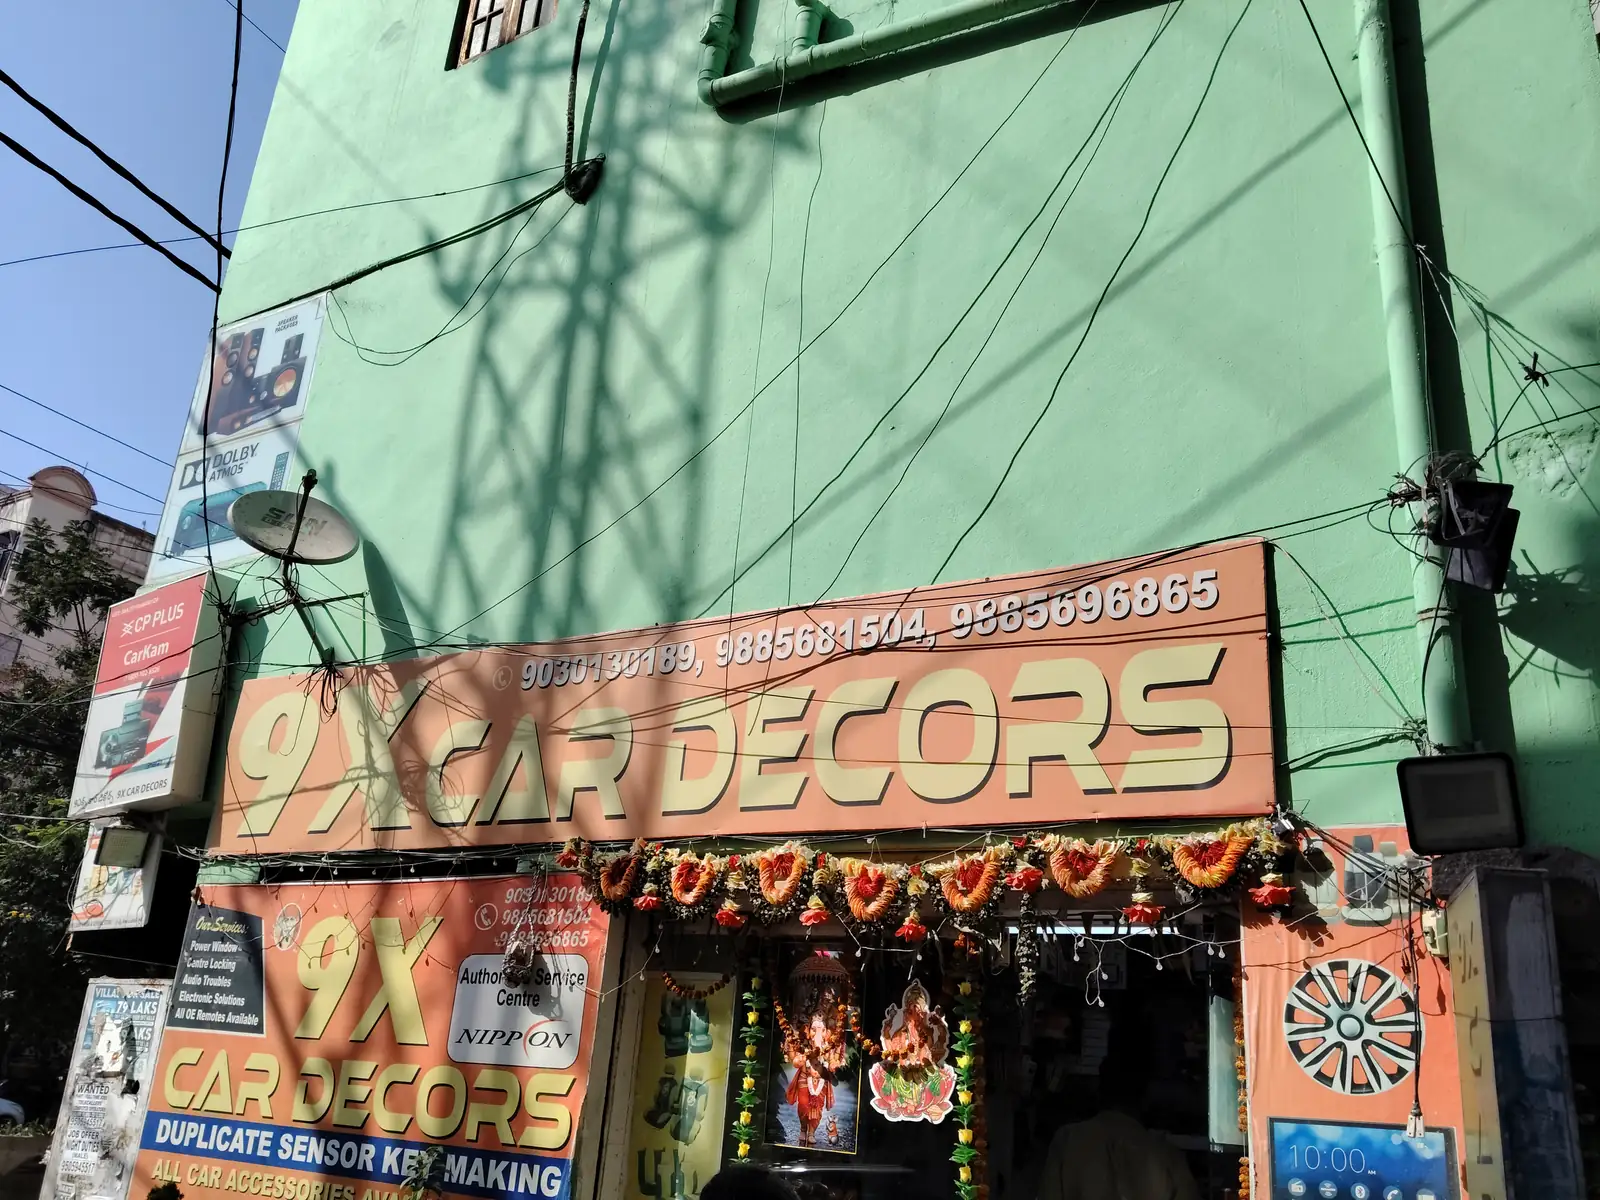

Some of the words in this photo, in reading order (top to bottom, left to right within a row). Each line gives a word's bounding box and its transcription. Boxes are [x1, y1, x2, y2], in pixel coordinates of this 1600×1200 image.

[212, 442, 260, 469] DOLBY
[208, 464, 244, 482] ATMOS
[134, 614, 152, 633] CP
[152, 602, 184, 628] PLUS
[520, 641, 704, 691] 9030130189,
[715, 608, 937, 667] 9885681504,
[950, 569, 1220, 638] 9885696865
[123, 642, 170, 666] CarKam
[427, 707, 635, 828] CAR
[661, 642, 1233, 816] DECORS
[126, 785, 140, 797] CAR
[140, 779, 168, 794] DECORS
[190, 940, 212, 952] Power
[210, 958, 237, 973] Locking
[182, 974, 202, 986] Audio
[203, 975, 232, 988] Troubles
[295, 916, 444, 1046] 9X
[535, 968, 585, 987] Service
[116, 1000, 128, 1014] 79
[130, 1001, 158, 1015] LAKS
[178, 990, 213, 1004] Electronic
[213, 992, 246, 1007] Solutions
[497, 988, 540, 1008] Centre
[175, 1007, 185, 1020] All
[186, 1008, 197, 1020] OE
[196, 1009, 226, 1023] Remotes
[226, 1011, 259, 1026] Available
[455, 1028, 573, 1049] NIPPON
[77, 1084, 110, 1095] WANTED
[164, 1048, 281, 1119] CAR
[292, 1057, 577, 1151] DECORS
[80, 1130, 100, 1140] OFFER
[156, 1118, 274, 1157] DUPLICATE
[278, 1132, 375, 1172] SENSOR
[444, 1153, 562, 1198] MAKING
[1289, 1144, 1366, 1174] 10:00
[151, 1158, 183, 1184] ALL
[187, 1163, 222, 1190] CAR
